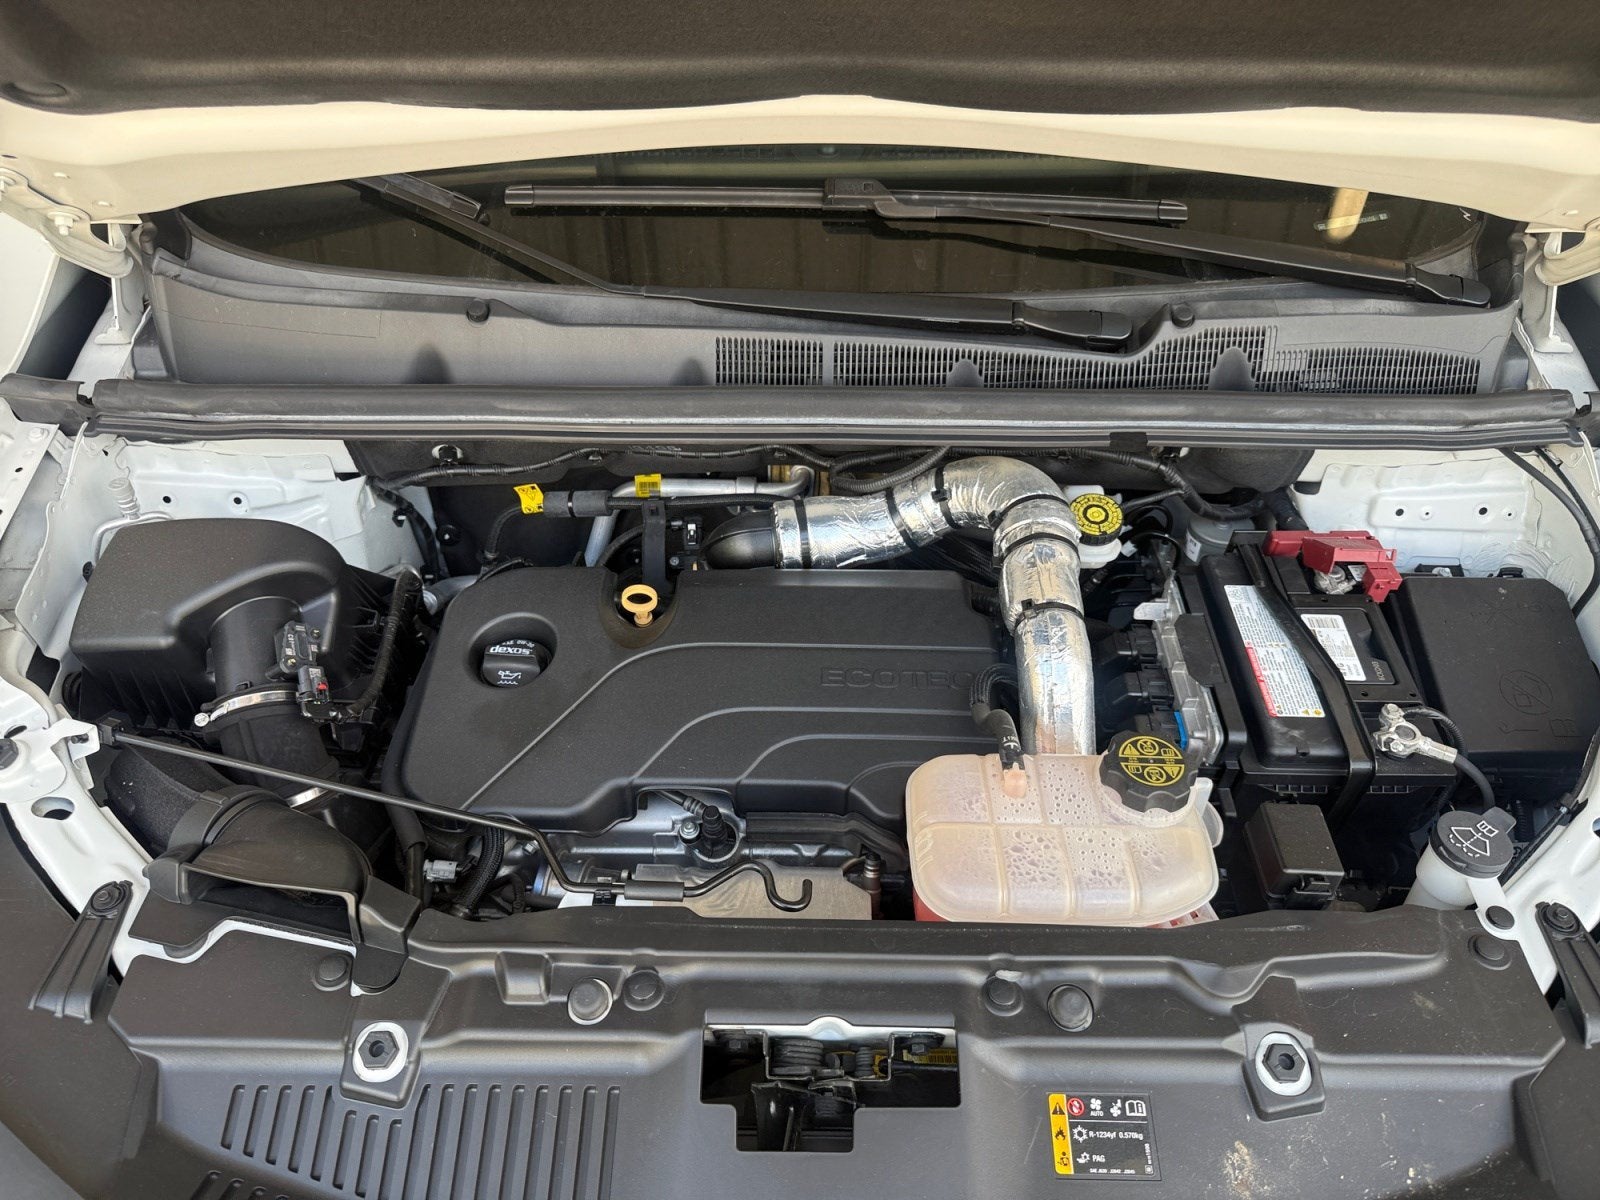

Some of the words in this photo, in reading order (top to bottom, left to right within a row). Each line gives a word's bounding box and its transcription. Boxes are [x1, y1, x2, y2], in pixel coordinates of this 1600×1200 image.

[489, 645, 530, 655] dexos
[820, 667, 976, 690] ECOTEC
[1088, 1130, 1117, 1139] R-1234yf
[1118, 1131, 1144, 1141] 0.570kg
[1092, 1154, 1106, 1162] PAG
